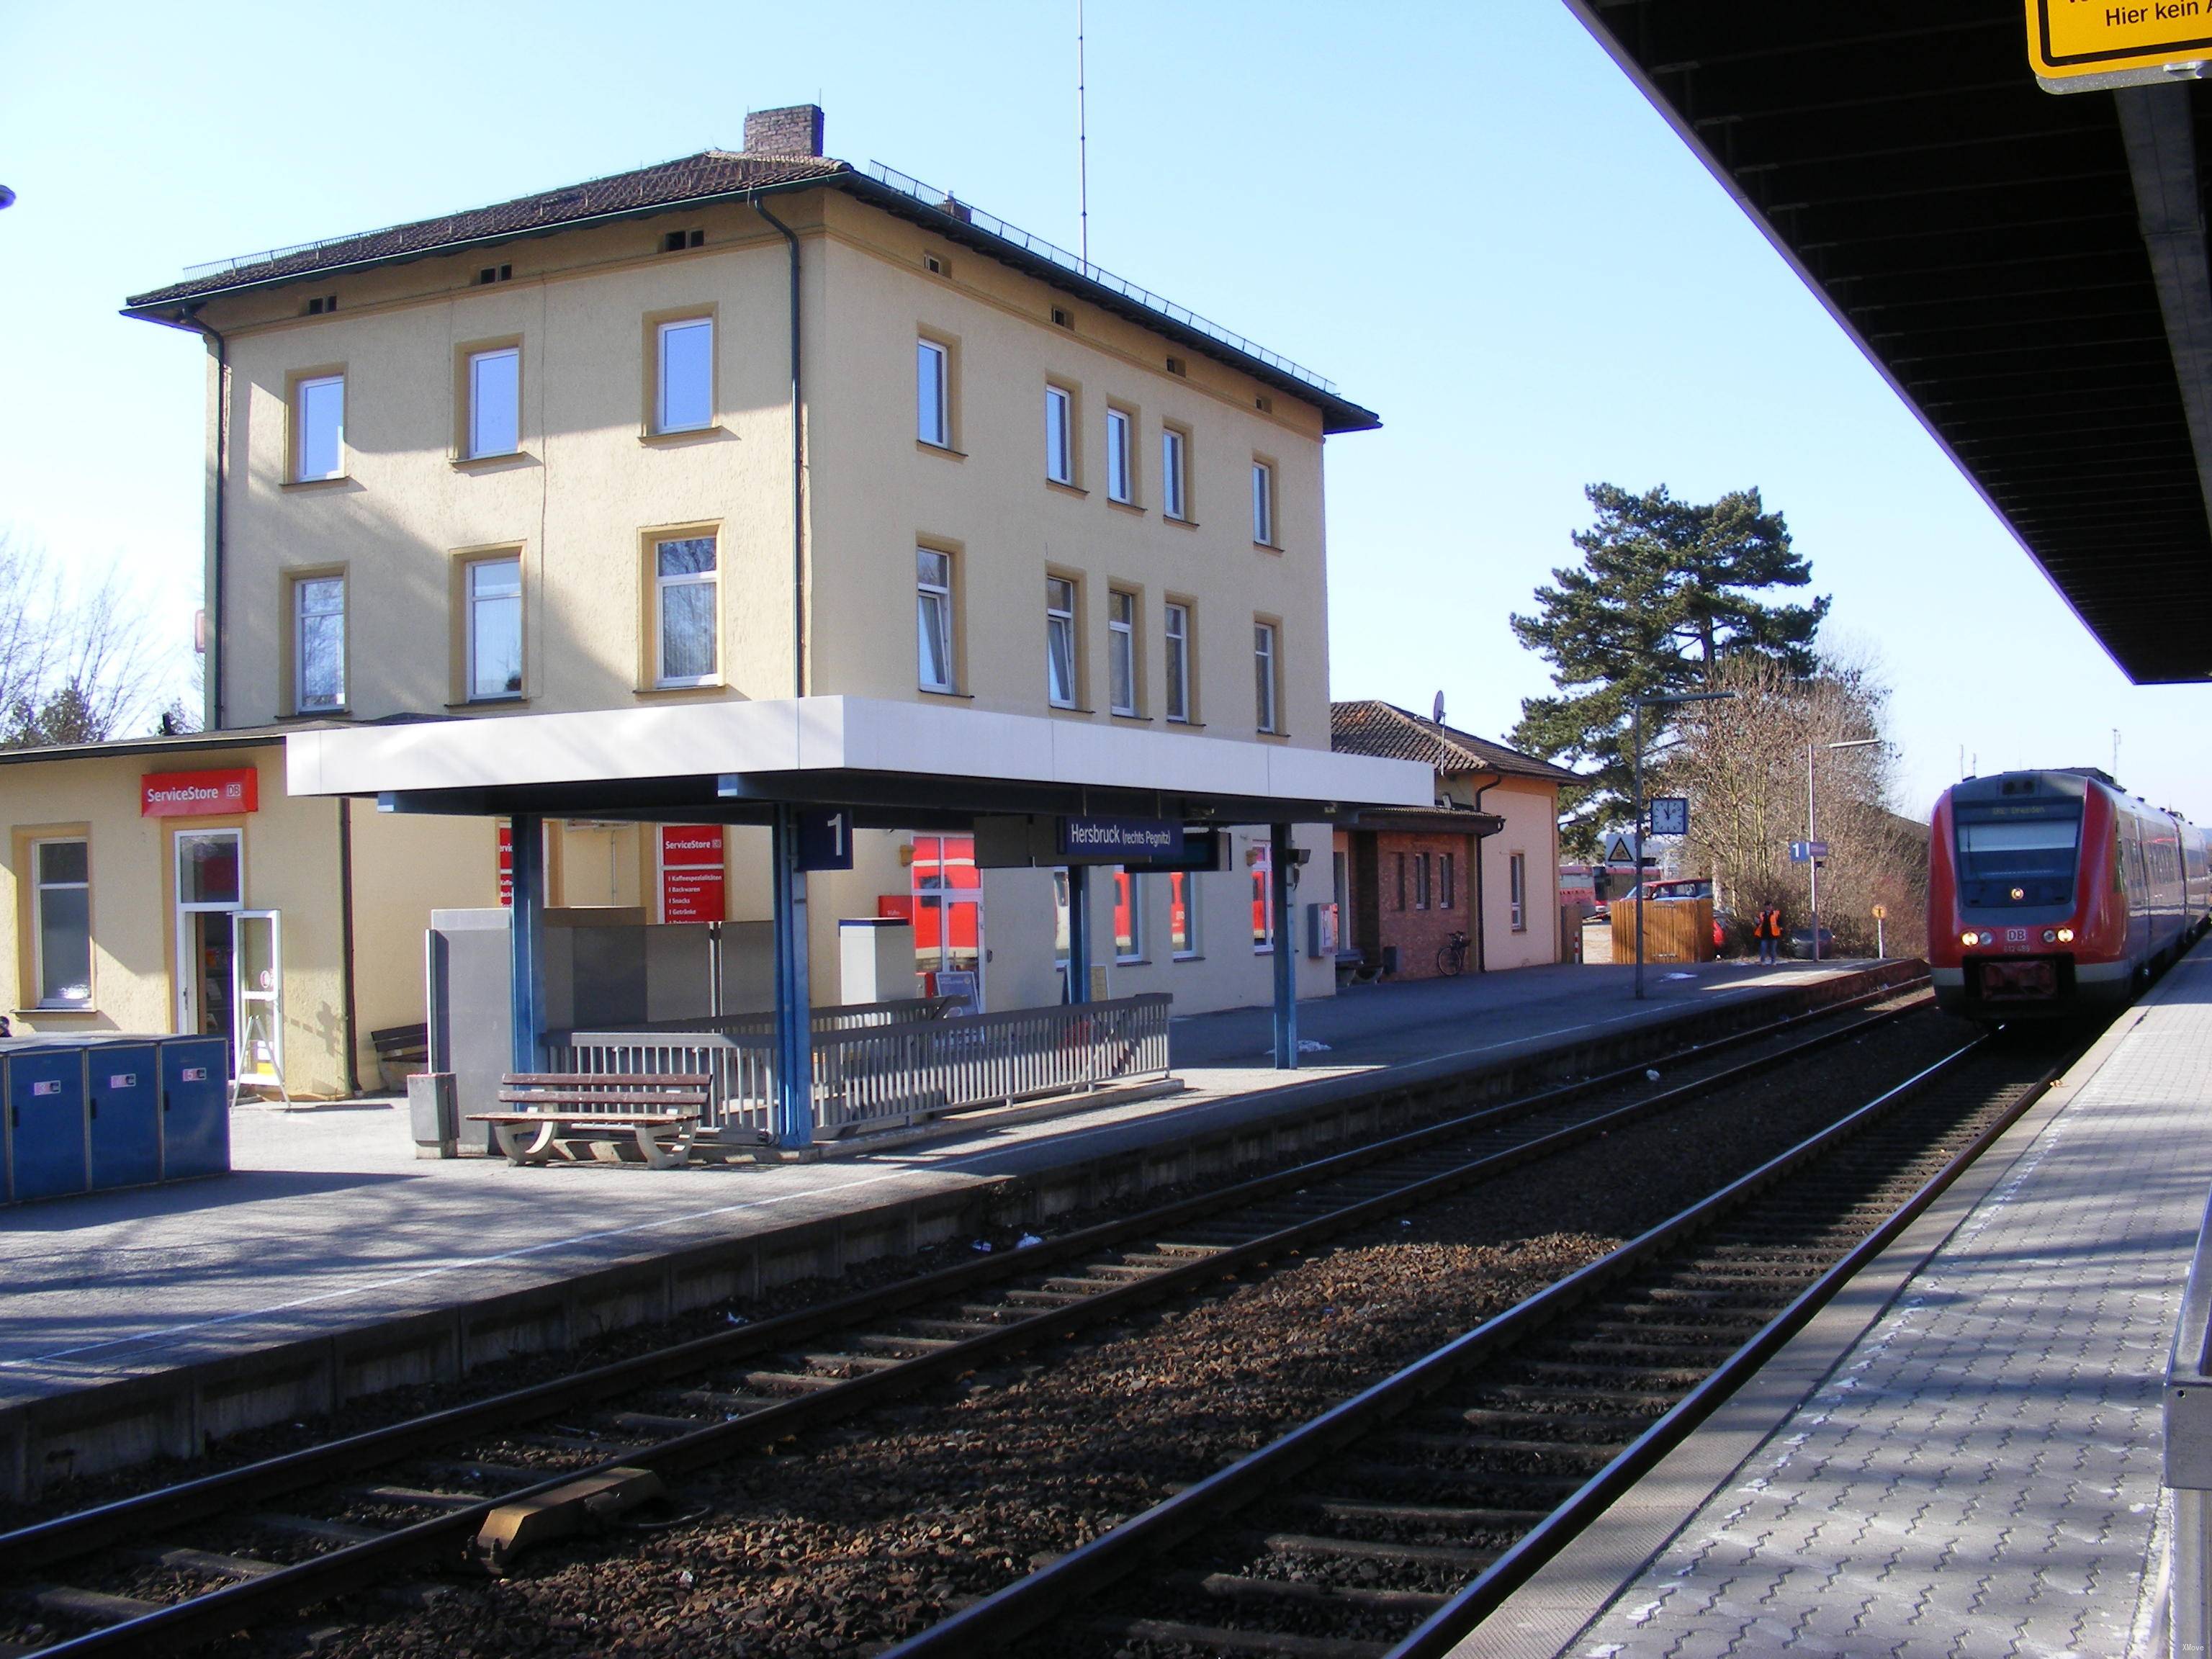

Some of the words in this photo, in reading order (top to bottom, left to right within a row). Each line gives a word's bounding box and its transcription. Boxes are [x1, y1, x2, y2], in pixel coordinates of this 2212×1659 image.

[2105, 7, 2148, 27] Hier
[2155, 0, 2198, 19] kein
[148, 786, 218, 802] ServiceStore
[227, 784, 240, 796] DB
[827, 813, 842, 855] 1
[1071, 824, 1120, 844] Hersbruck
[1123, 830, 1144, 845] (rechts
[1146, 830, 1171, 848] Pegnitz)
[665, 840, 711, 849] ServiceStore
[1792, 842, 1799, 857] 1
[2008, 930, 2025, 940] DB
